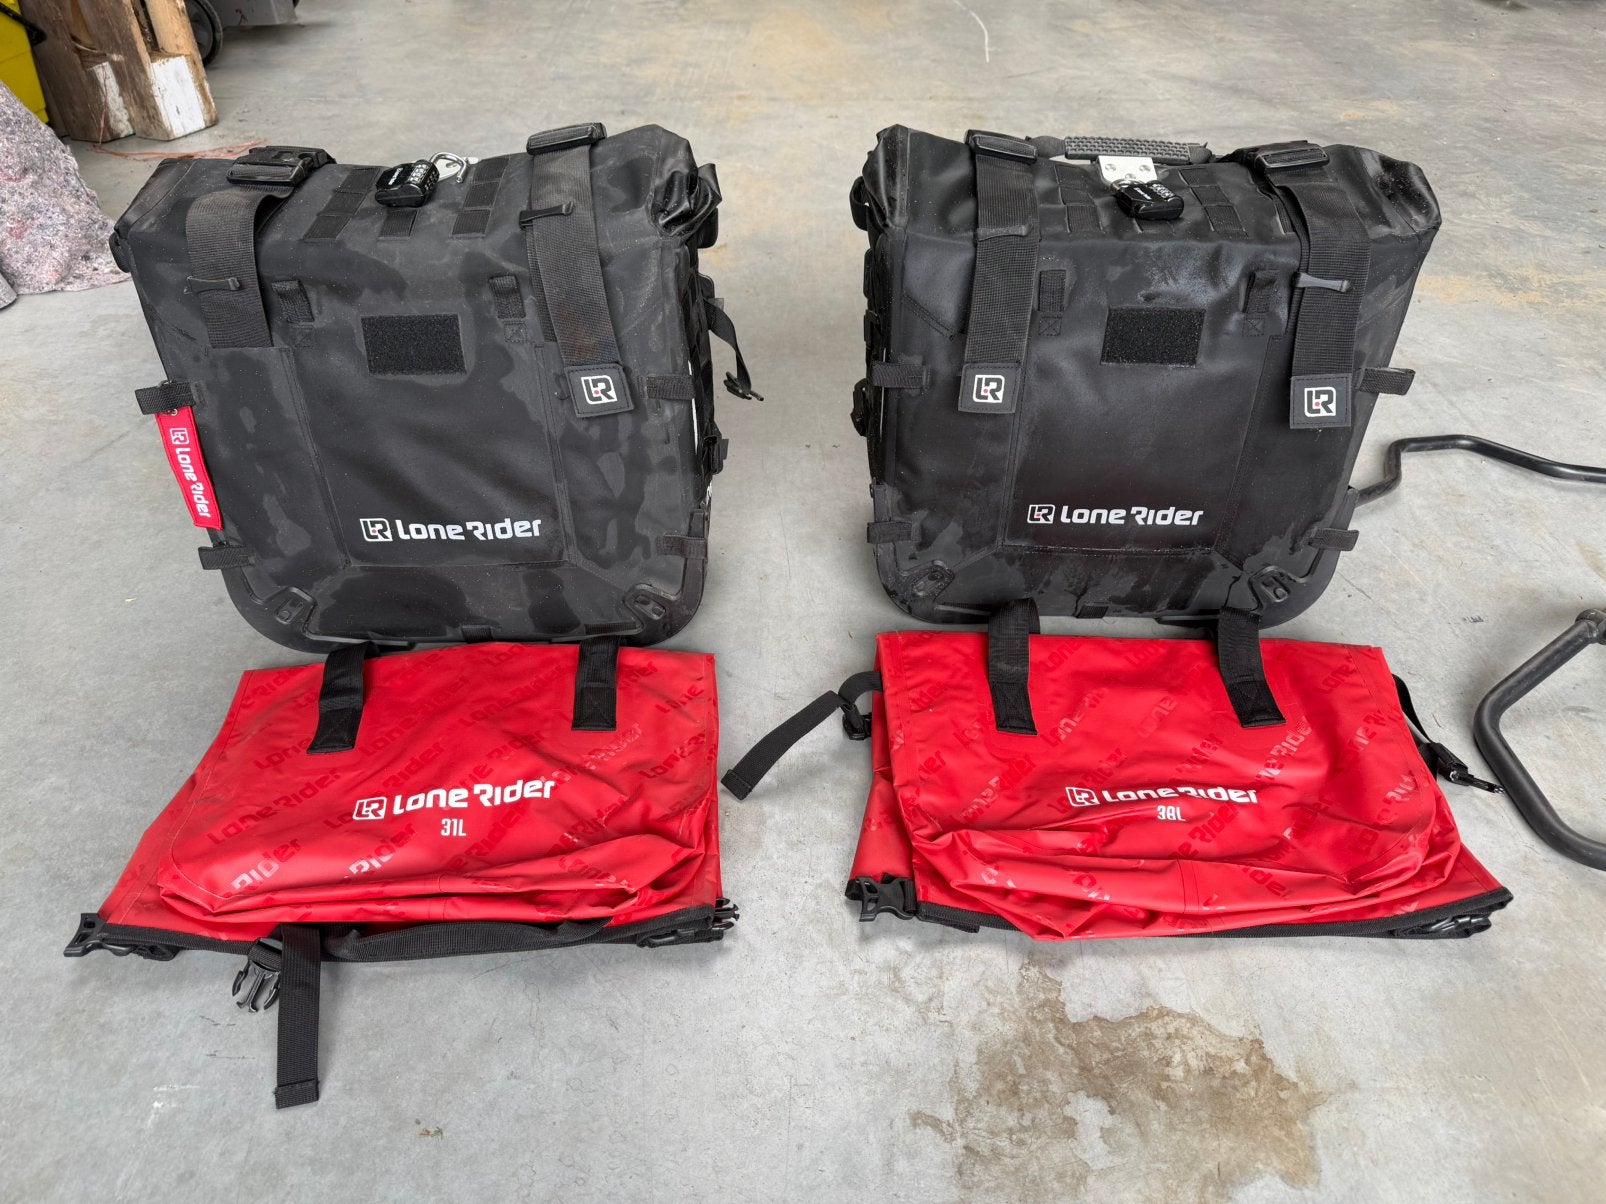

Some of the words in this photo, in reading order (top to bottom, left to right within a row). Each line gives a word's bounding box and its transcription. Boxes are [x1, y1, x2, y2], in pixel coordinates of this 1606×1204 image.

[175, 447, 199, 482] Lone
[1060, 505, 1127, 525] Lone
[1130, 506, 1204, 526] Rider
[395, 519, 466, 541] Lone
[466, 518, 542, 541] Rider
[393, 788, 469, 815] Lone
[473, 779, 556, 807] Rider
[1102, 787, 1176, 803] Lone
[441, 818, 467, 837] 31L
